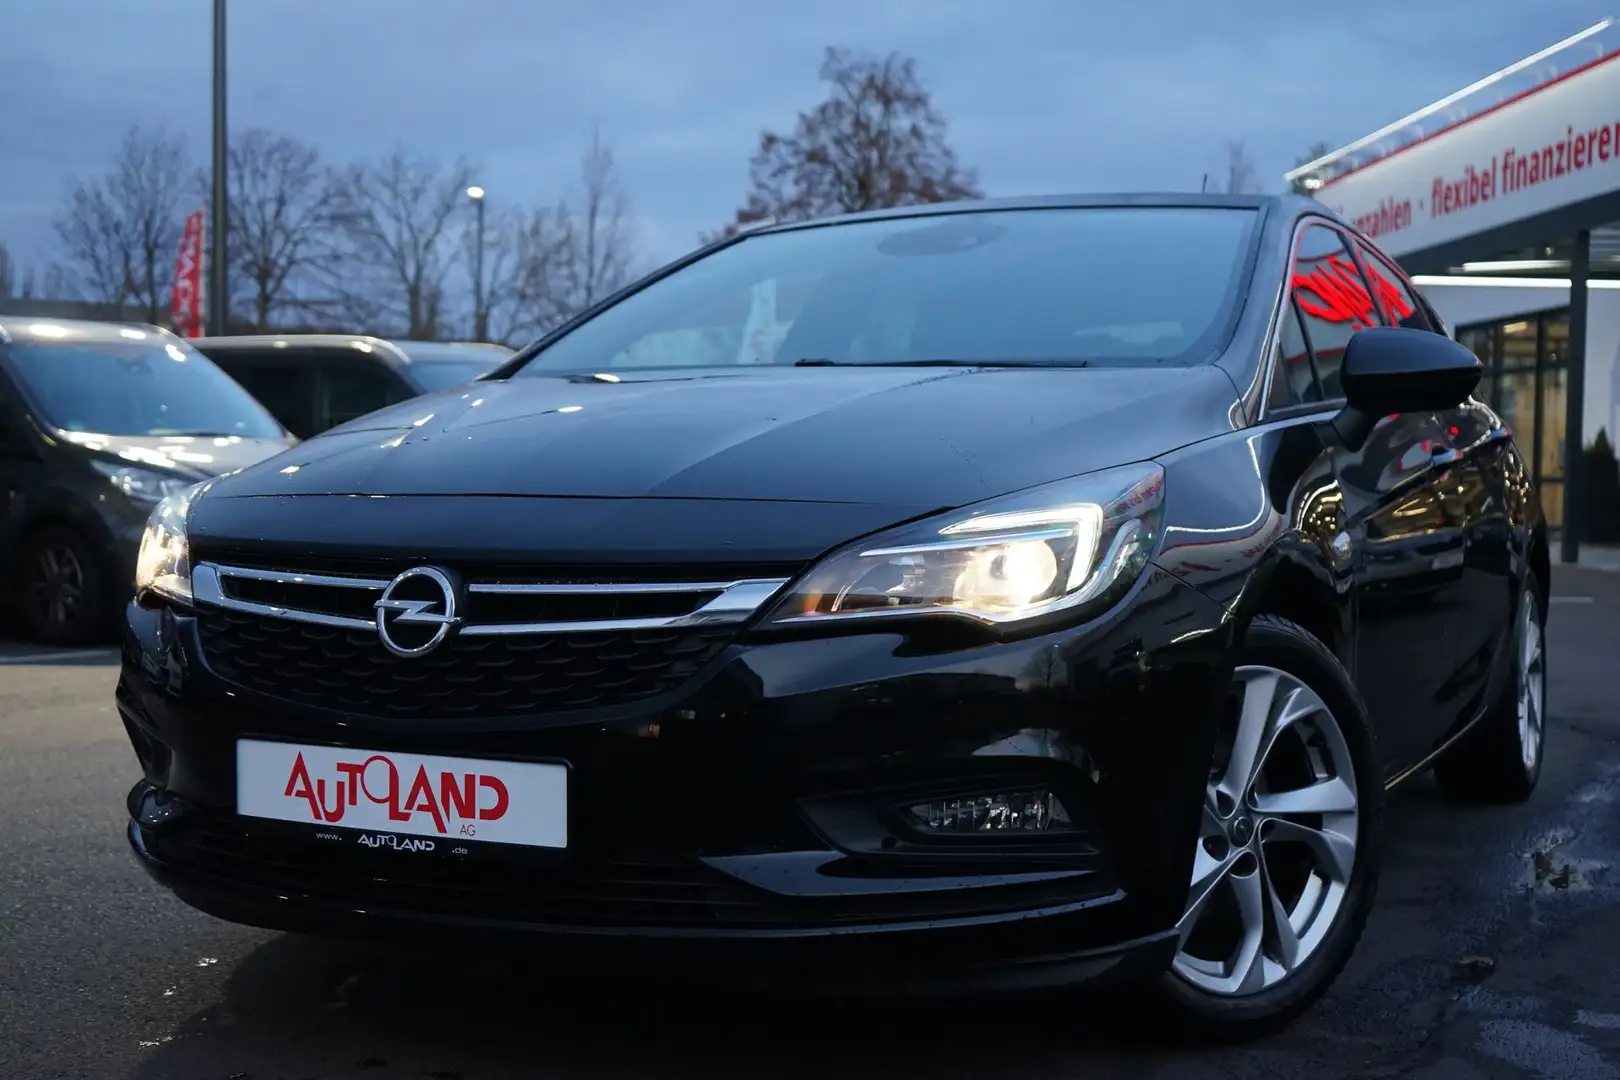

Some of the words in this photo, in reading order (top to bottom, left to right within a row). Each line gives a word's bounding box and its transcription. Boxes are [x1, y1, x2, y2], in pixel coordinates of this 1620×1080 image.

[1432, 155, 1497, 218] flexibel
[284, 751, 510, 833] AUTOLAND
[316, 832, 342, 841] www.
[357, 833, 435, 852] AUTOLAND
[459, 824, 476, 837] AG
